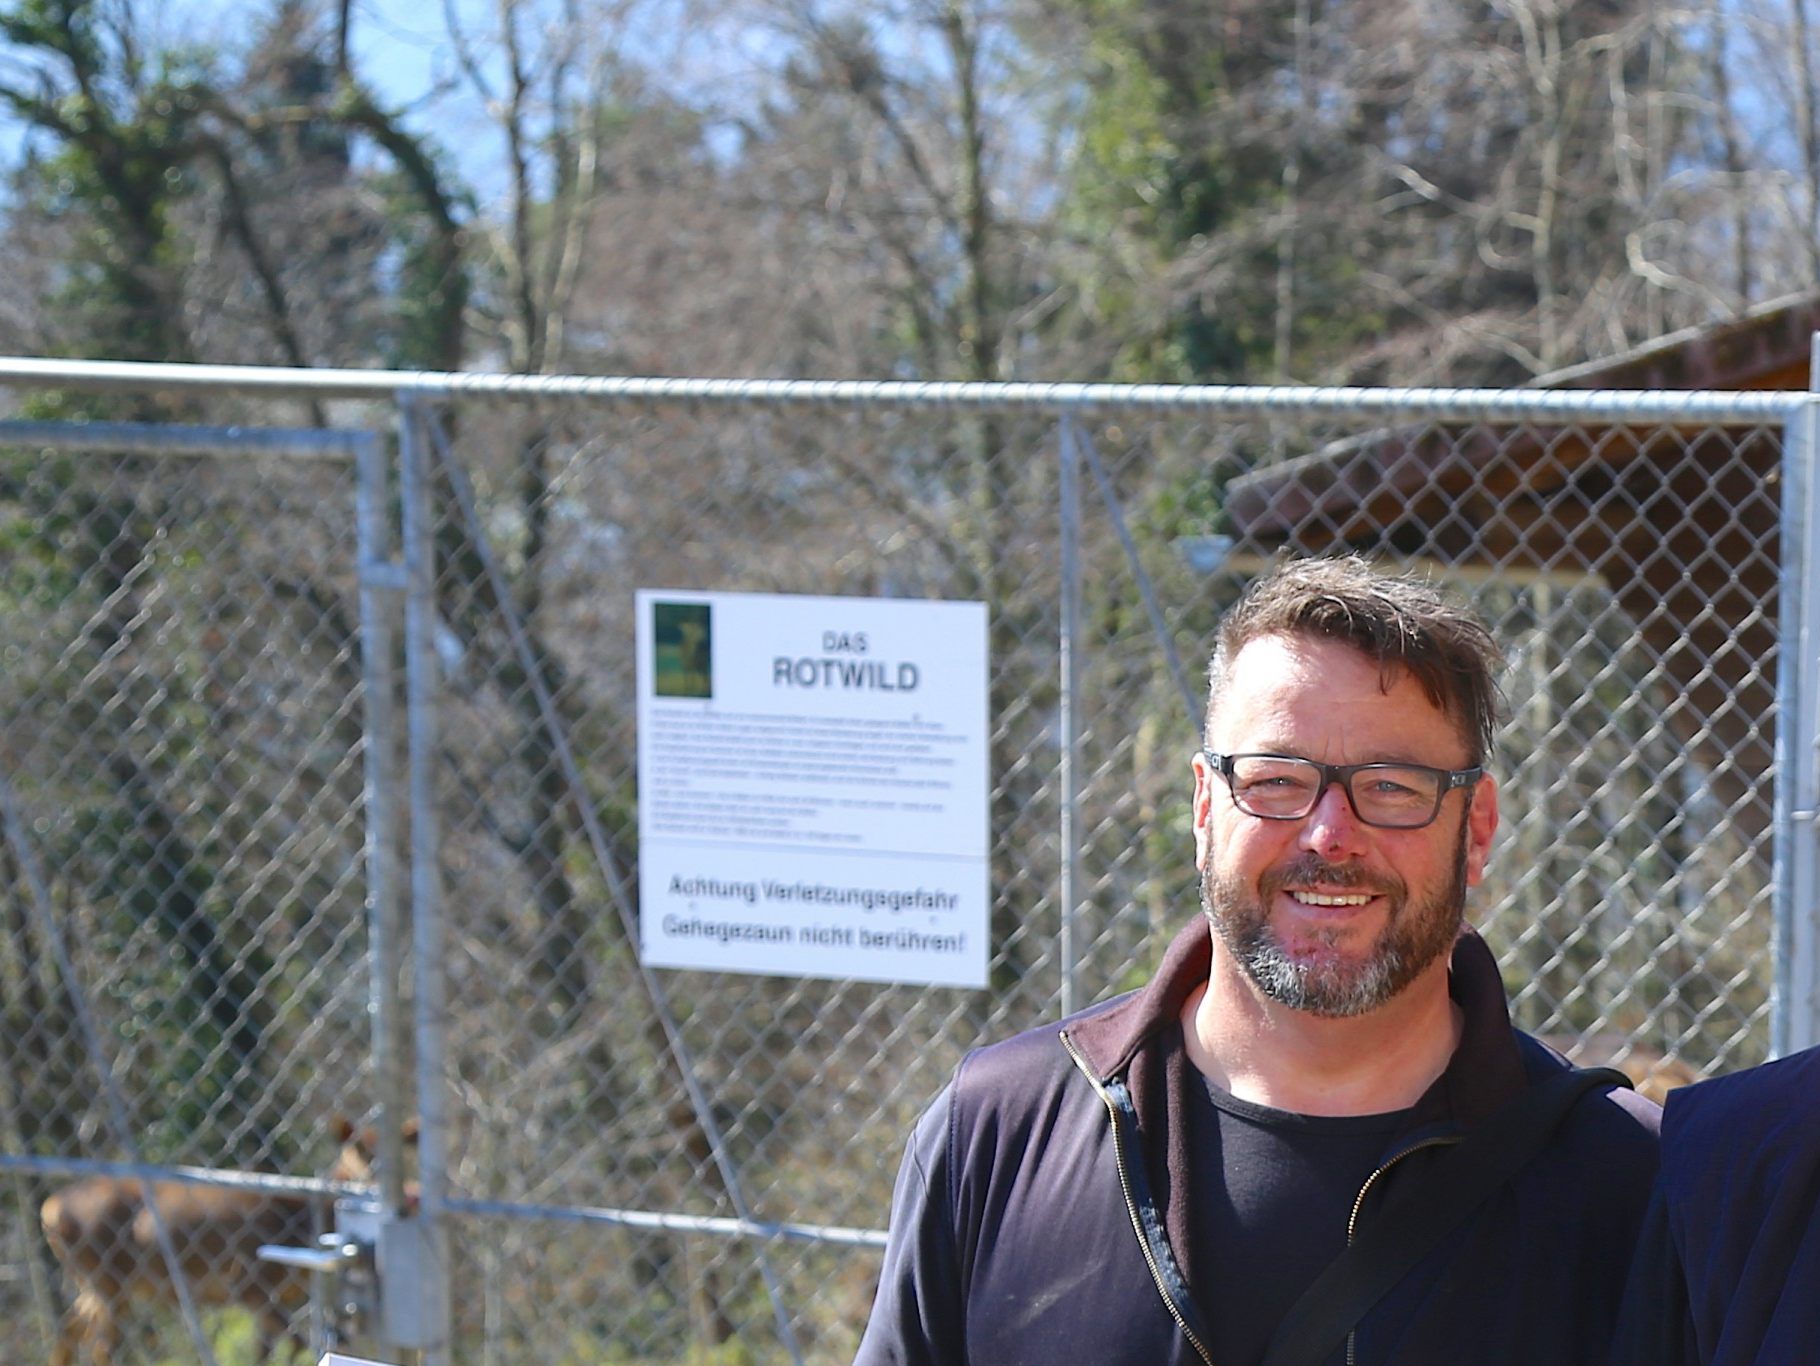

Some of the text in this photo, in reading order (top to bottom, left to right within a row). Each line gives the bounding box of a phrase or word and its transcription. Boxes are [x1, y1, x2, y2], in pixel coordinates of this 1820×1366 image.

[823, 630, 868, 653] DAS
[773, 657, 919, 690] ROTWILD
[668, 874, 958, 911] Achtung Verletzungsgefahr
[663, 914, 966, 952] Gehegezaun nicht berühren!
